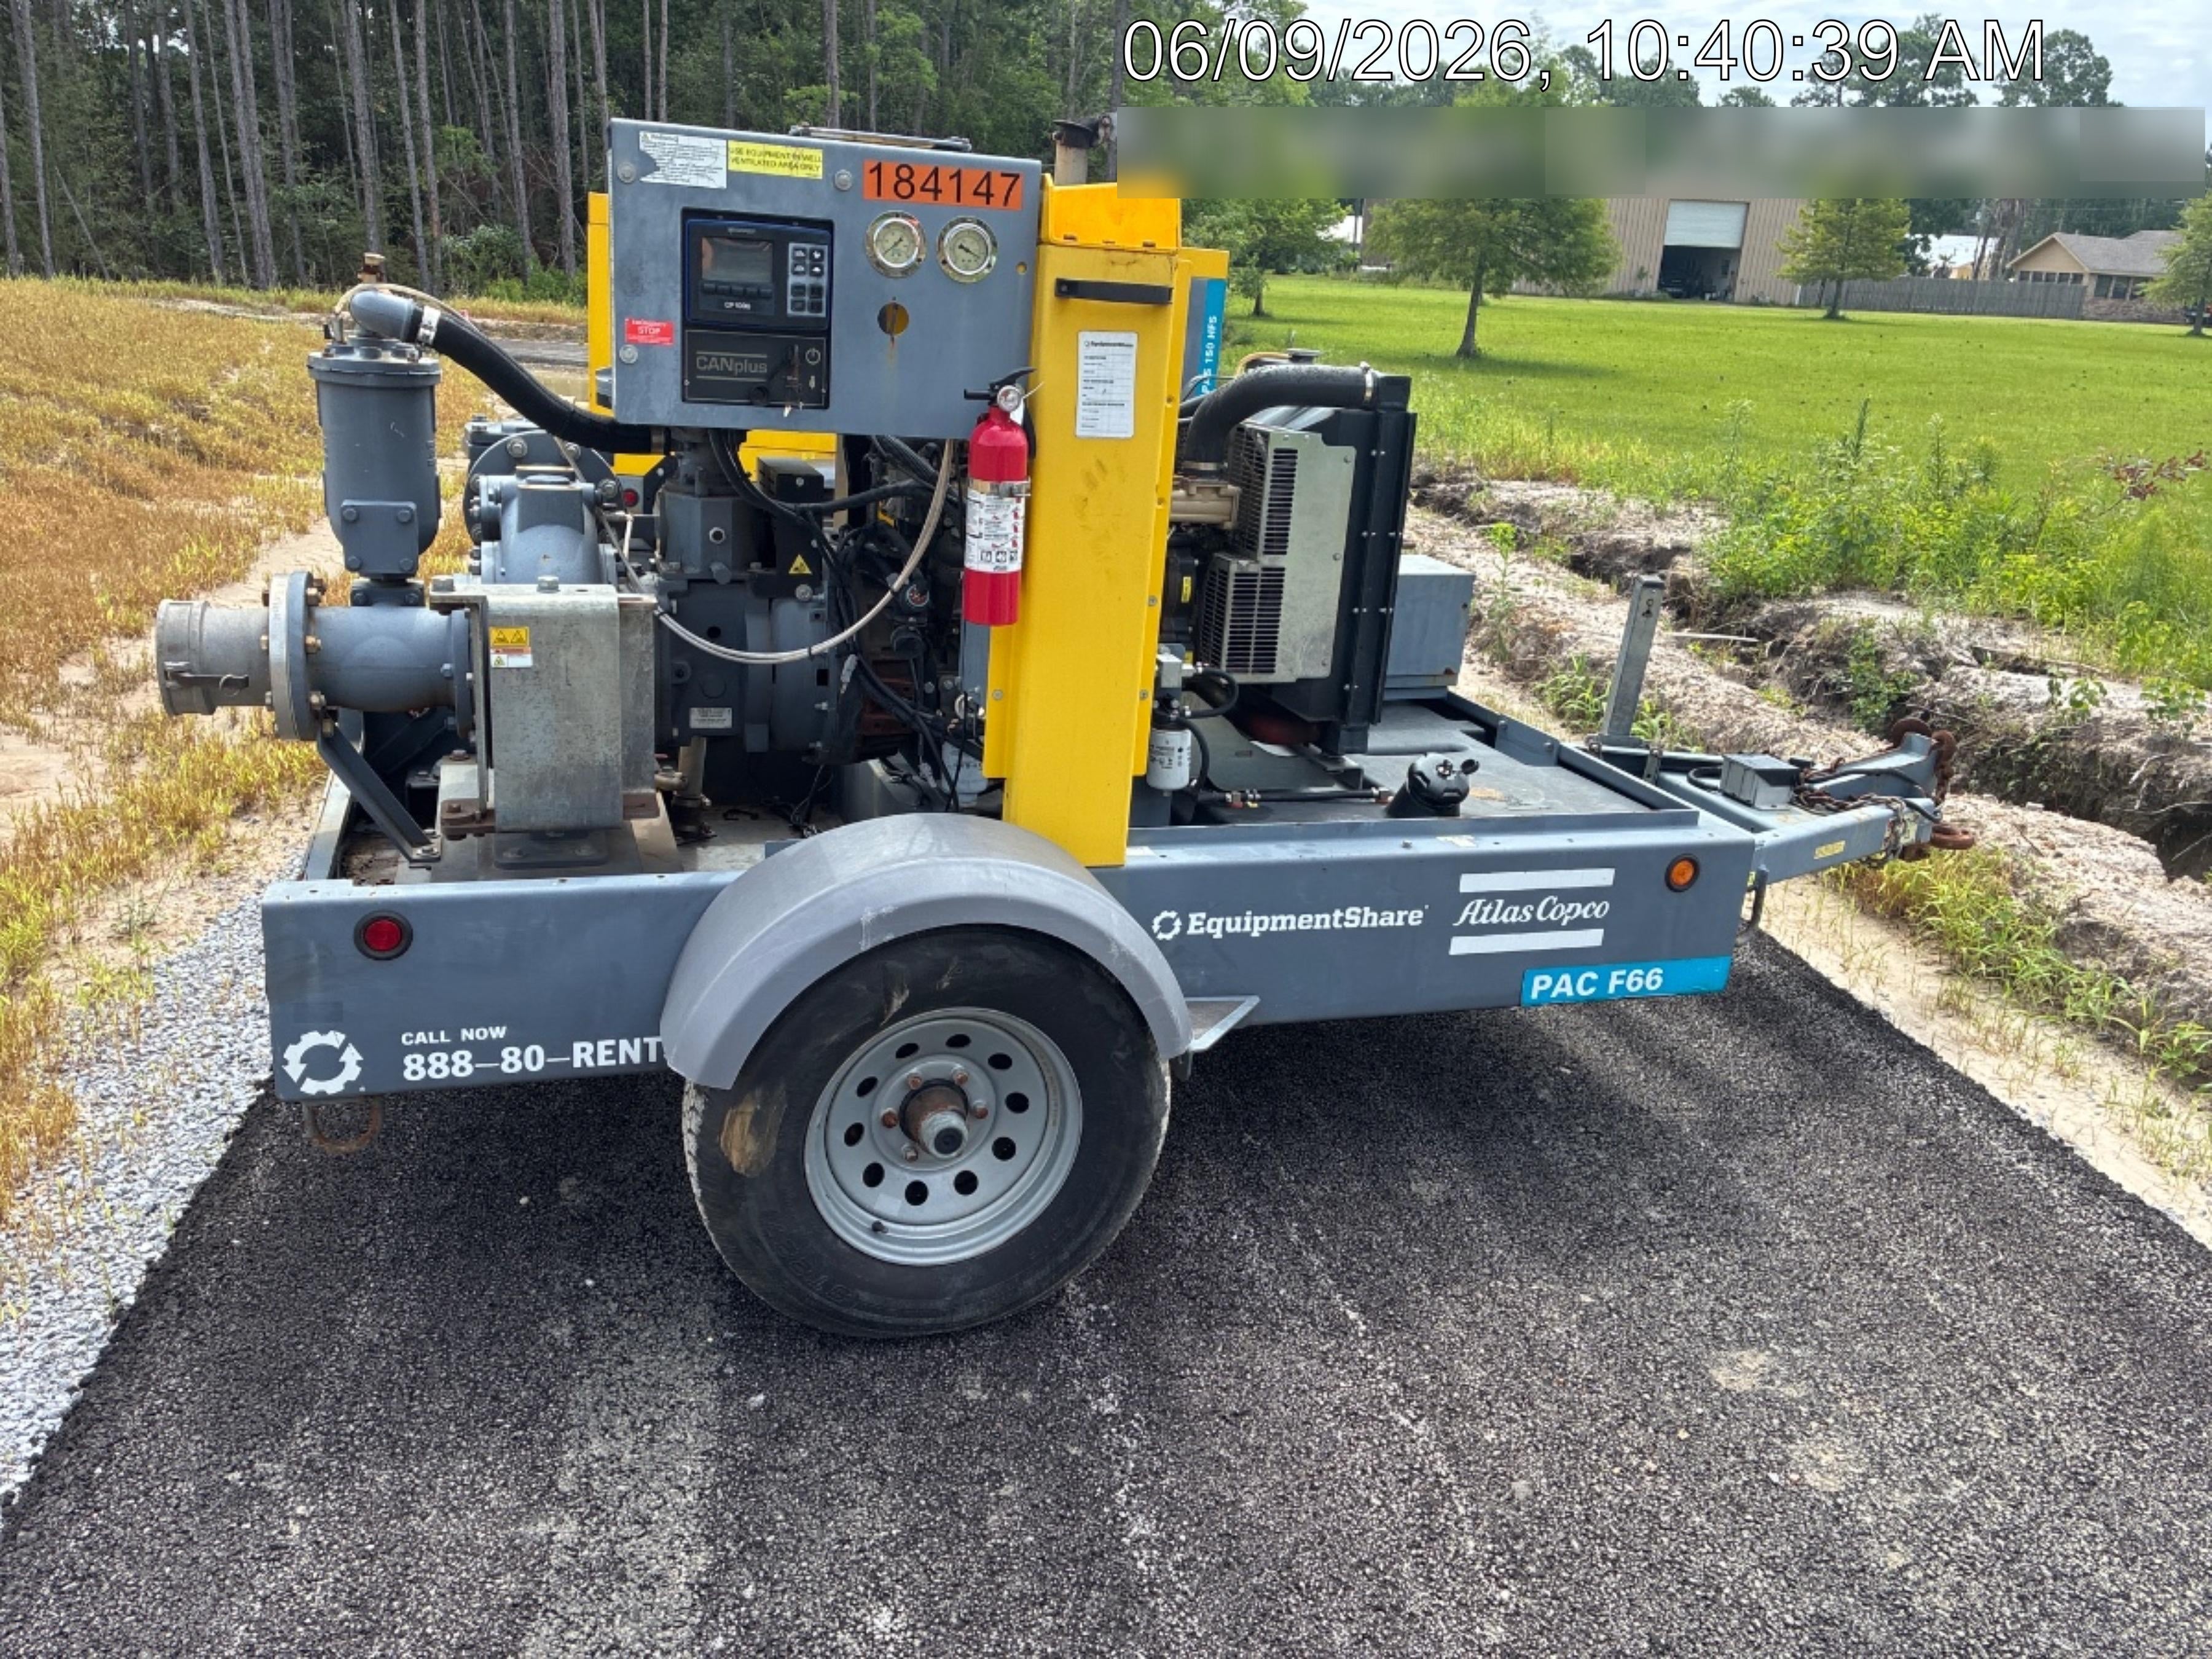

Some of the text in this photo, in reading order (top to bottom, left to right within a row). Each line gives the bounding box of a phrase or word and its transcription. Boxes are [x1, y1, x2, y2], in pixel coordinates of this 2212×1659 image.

[868, 161, 1021, 208] 184147
[637, 326, 661, 335] STOP
[1207, 315, 1217, 339] HFS
[1205, 342, 1215, 364] 150
[696, 356, 767, 375] CANplus
[1186, 906, 1424, 939] EquipmentShare
[1453, 895, 1610, 926] Atlas Copco
[1530, 967, 1664, 1000] PAC F66
[401, 1026, 508, 1046] CALL NOW
